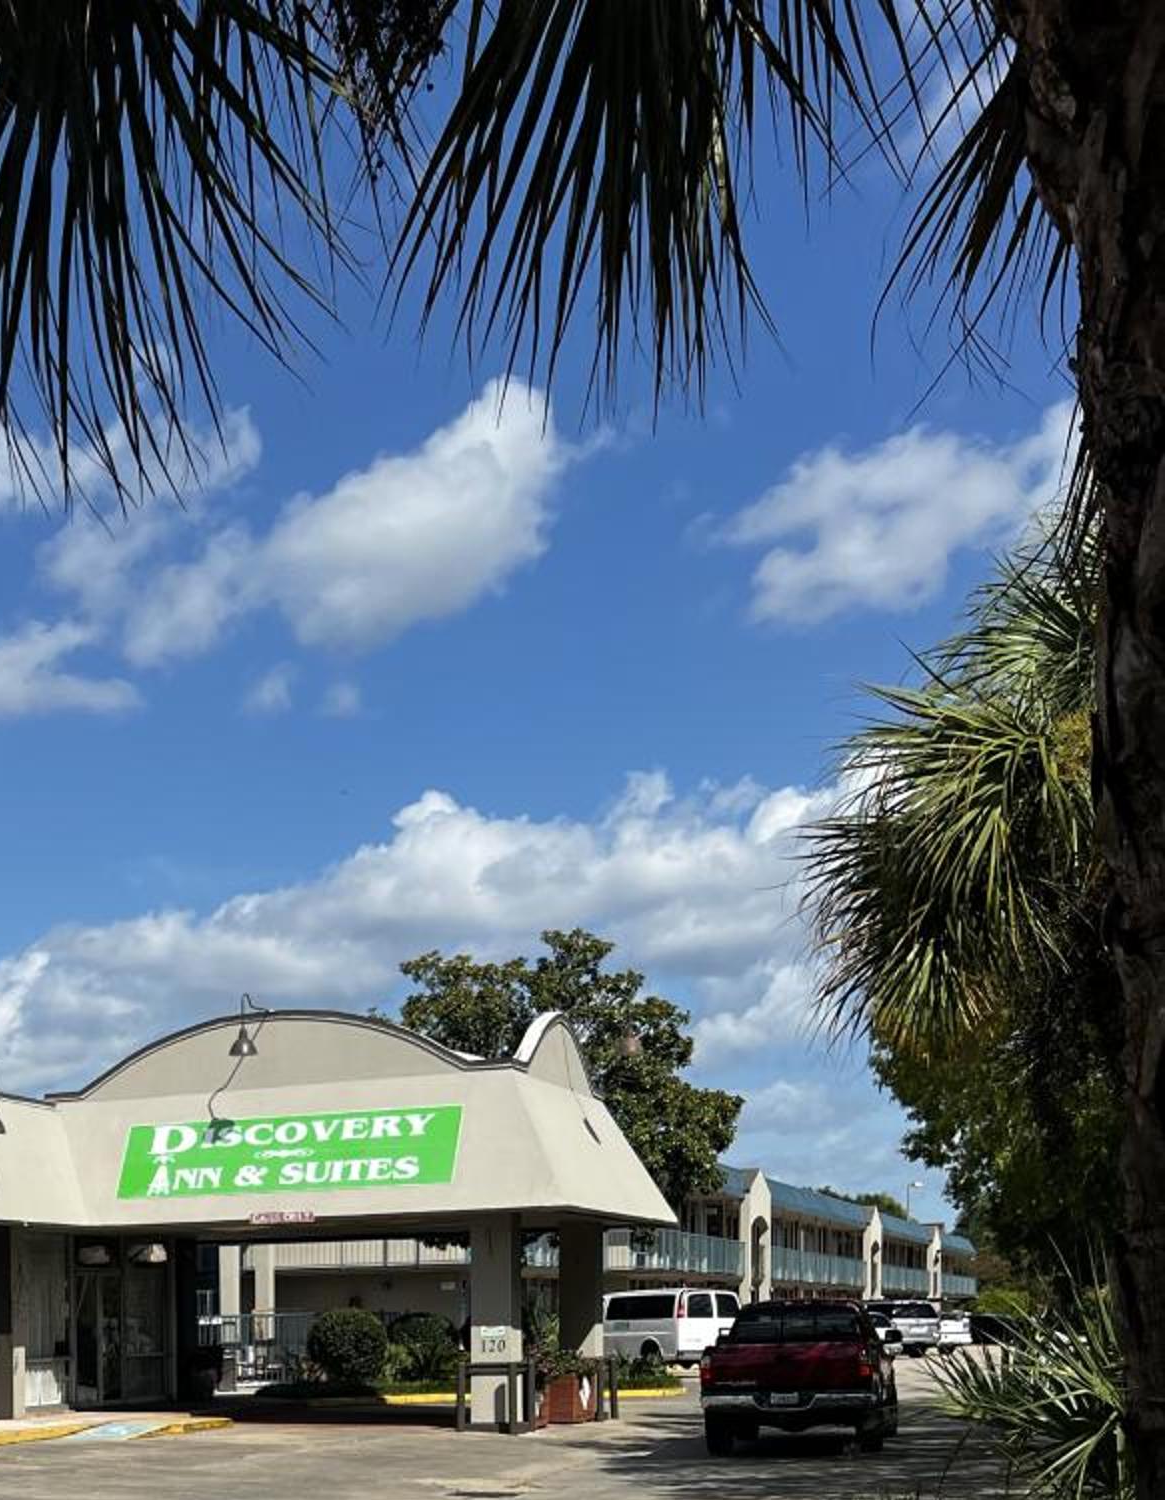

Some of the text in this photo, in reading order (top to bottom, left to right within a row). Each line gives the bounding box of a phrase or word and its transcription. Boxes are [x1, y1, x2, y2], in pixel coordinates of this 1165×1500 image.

[147, 1113, 436, 1156] DISCOVERY
[234, 1165, 268, 1187] &
[278, 1156, 420, 1185] SUITES
[482, 1339, 506, 1353] 120
